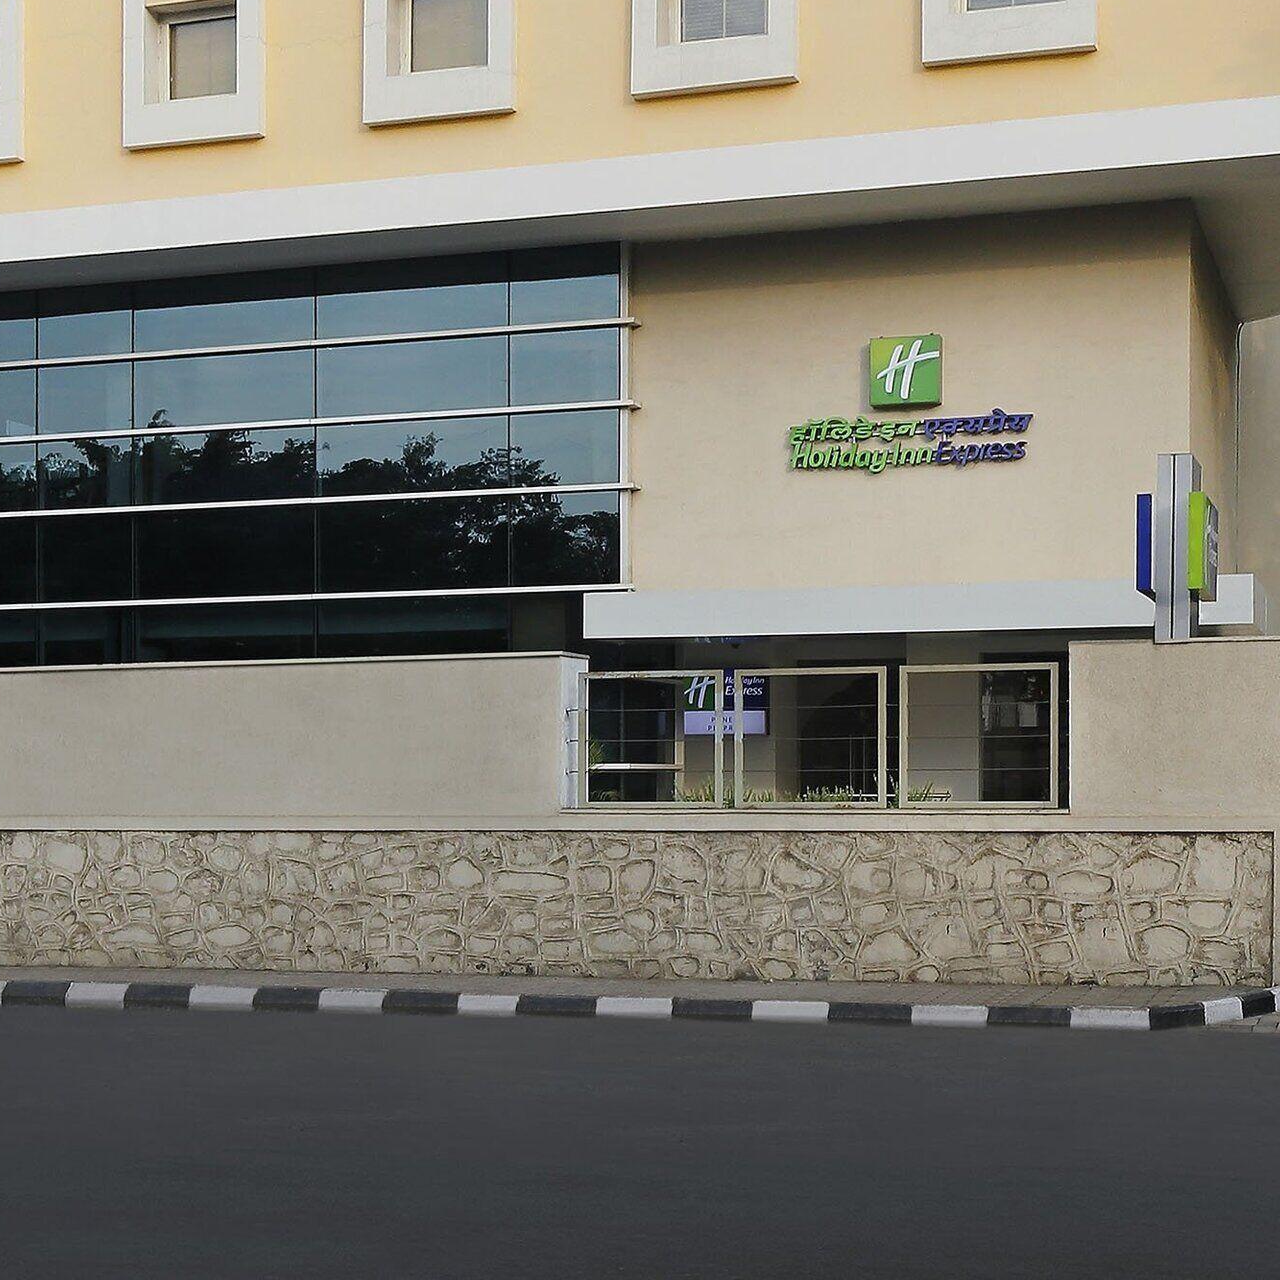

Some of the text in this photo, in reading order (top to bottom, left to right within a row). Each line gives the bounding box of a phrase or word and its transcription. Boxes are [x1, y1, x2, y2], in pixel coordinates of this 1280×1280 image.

[879, 421, 920, 442] इन
[791, 441, 1029, 473] Holiday Inn Express
